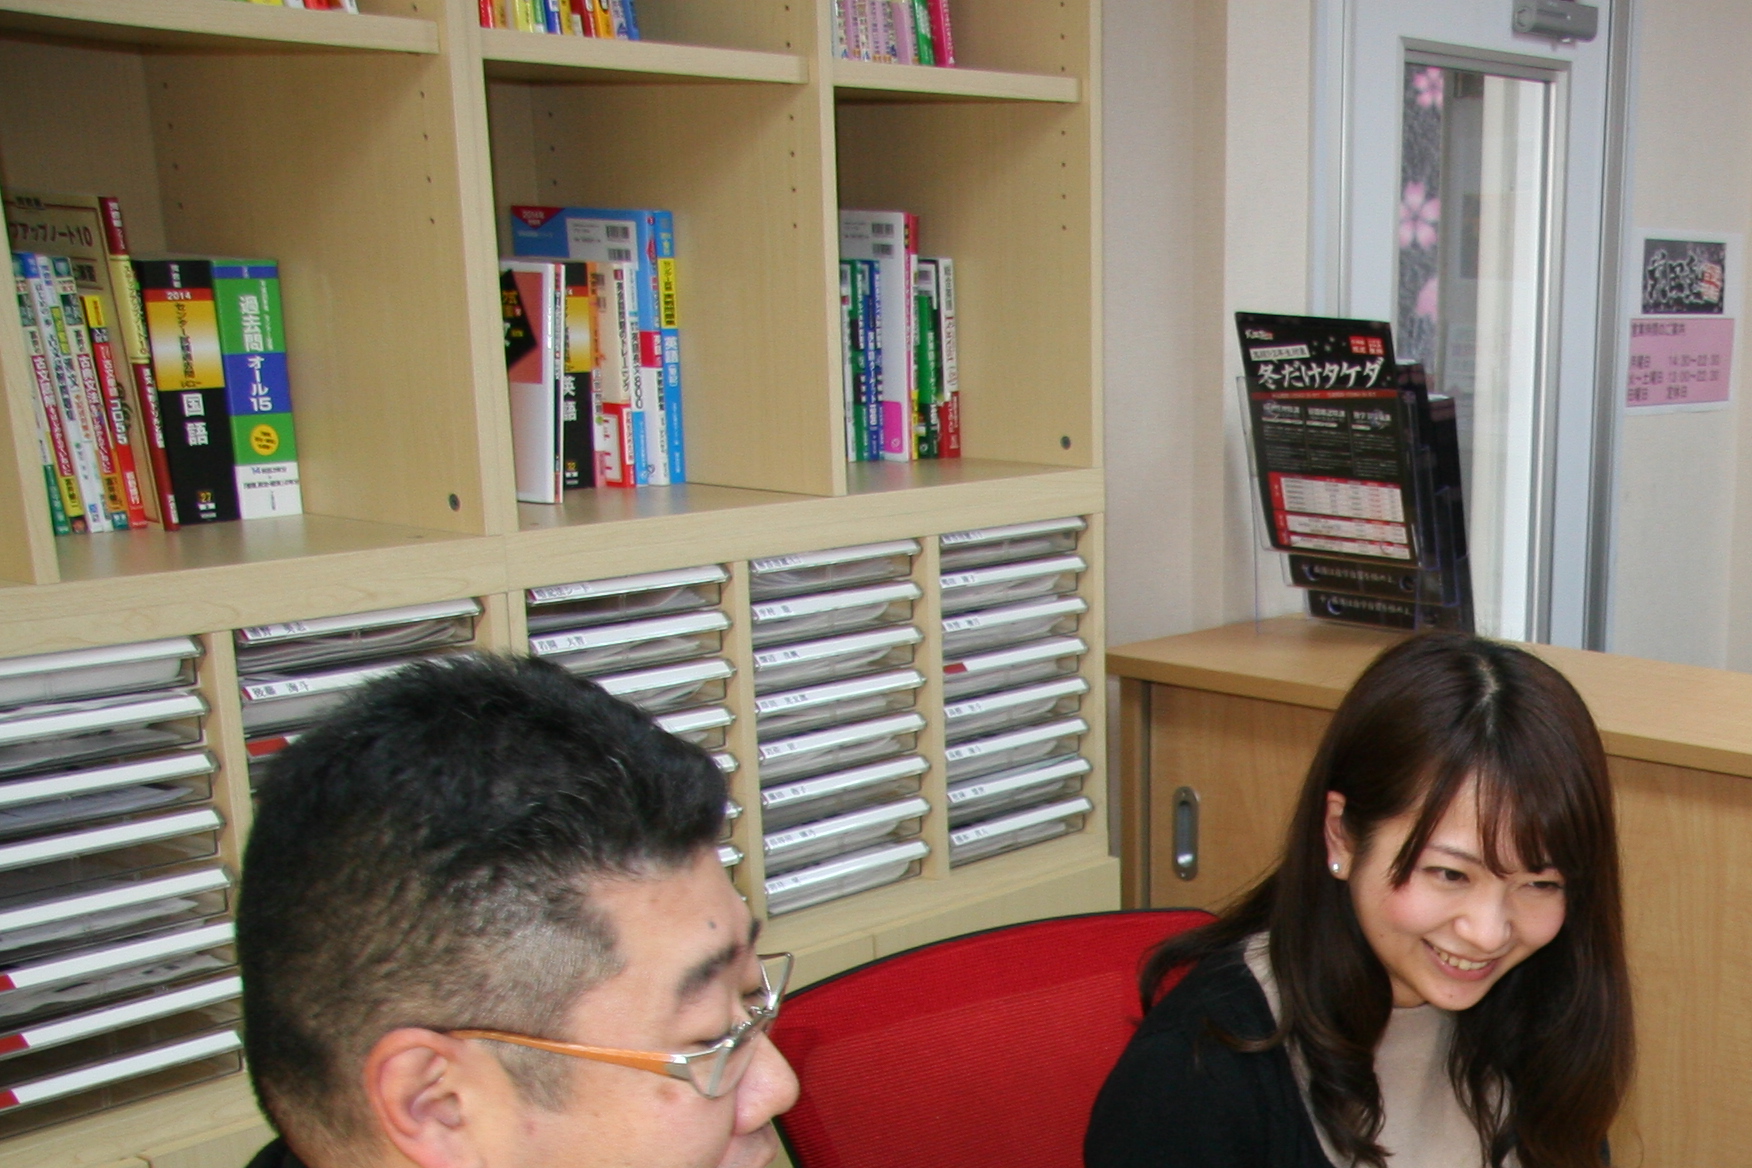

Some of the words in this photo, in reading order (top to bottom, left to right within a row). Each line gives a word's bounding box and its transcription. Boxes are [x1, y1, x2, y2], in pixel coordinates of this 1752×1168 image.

[166, 291, 192, 300] 2014
[239, 295, 264, 352] 過去問
[664, 336, 678, 363] 英語
[248, 355, 273, 411] オール15
[1257, 357, 1384, 390] 冬だけタケダ
[183, 393, 209, 446] 国語
